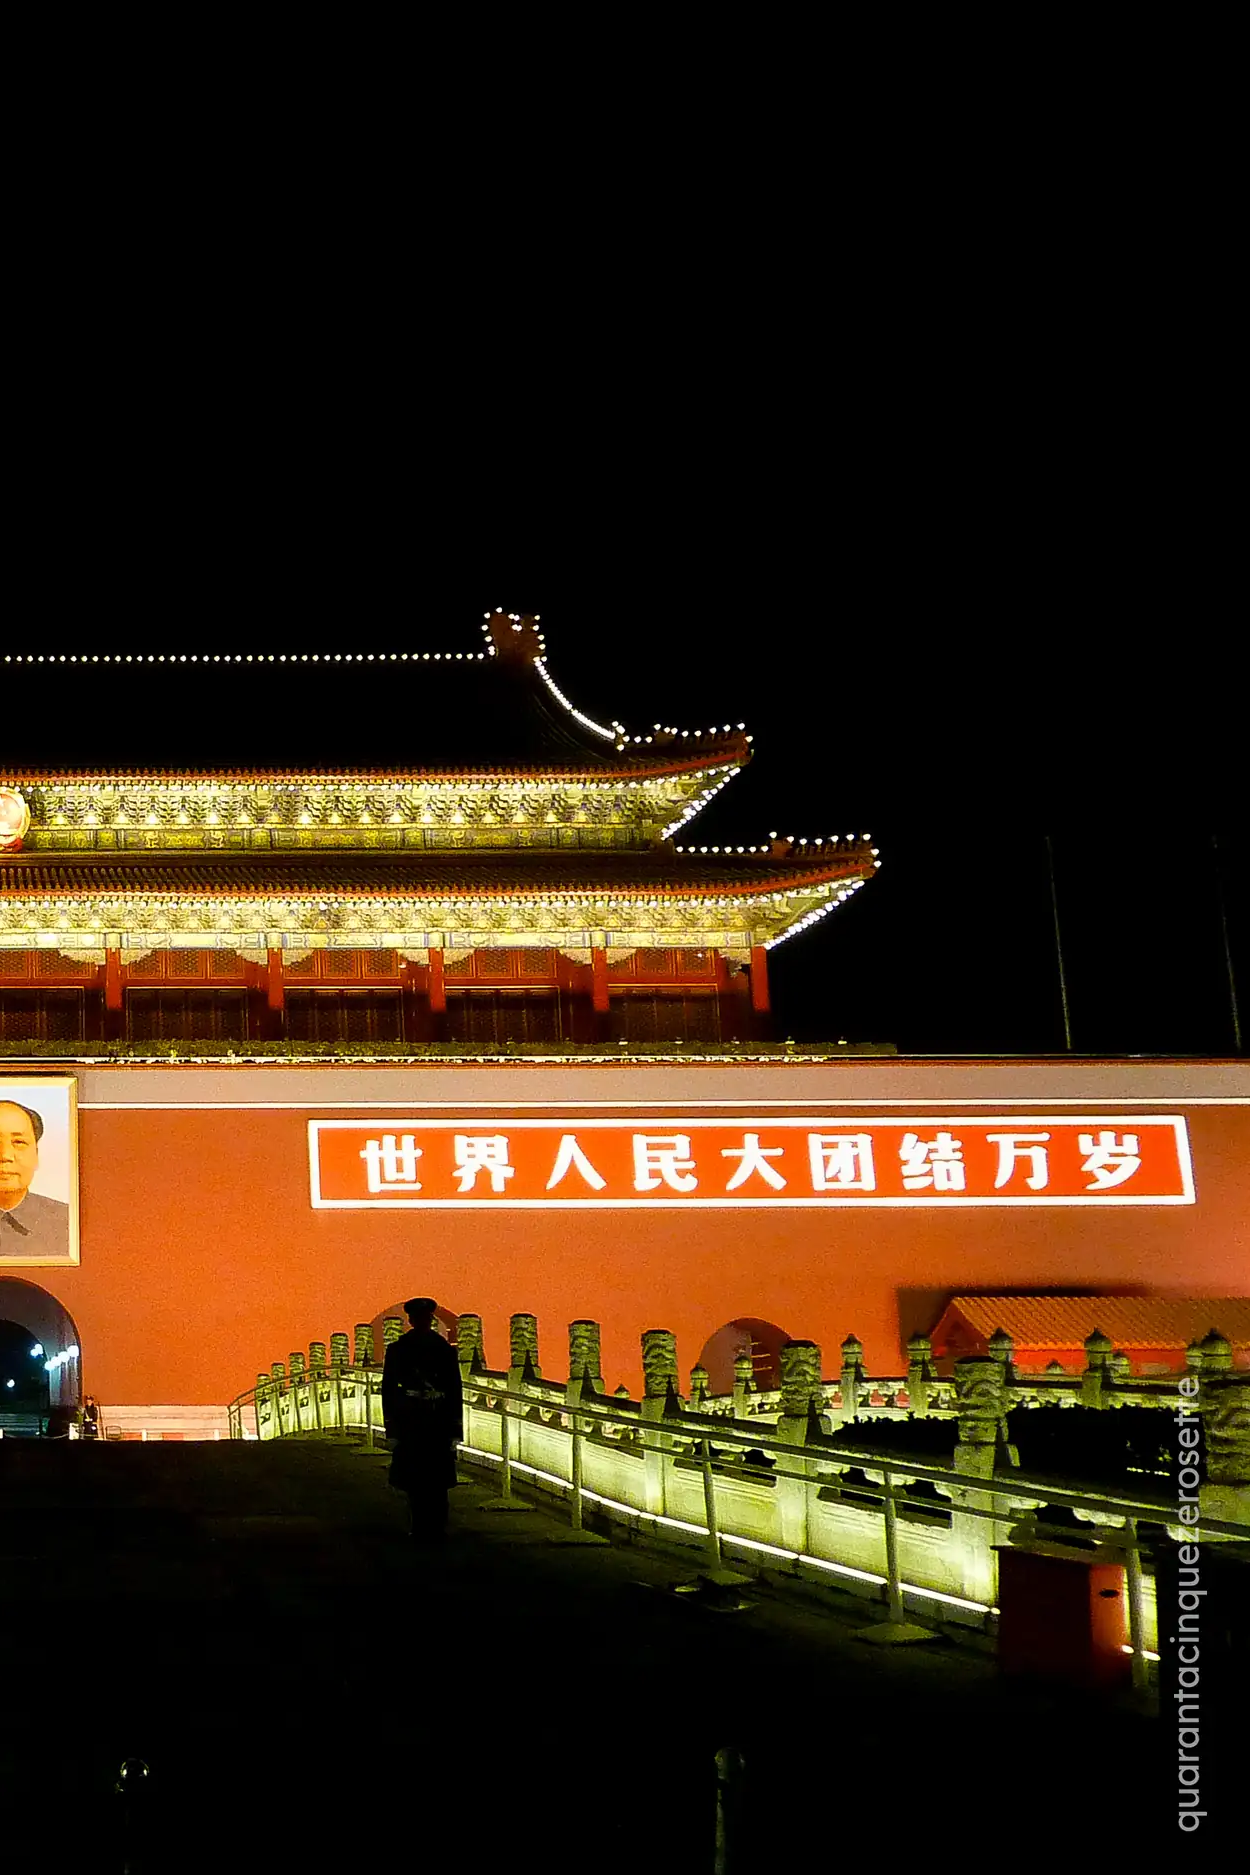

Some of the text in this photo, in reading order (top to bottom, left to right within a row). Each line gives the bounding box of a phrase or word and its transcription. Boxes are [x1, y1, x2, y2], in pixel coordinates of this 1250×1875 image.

[359, 1130, 1141, 1193] 世界人民大团结万岁
